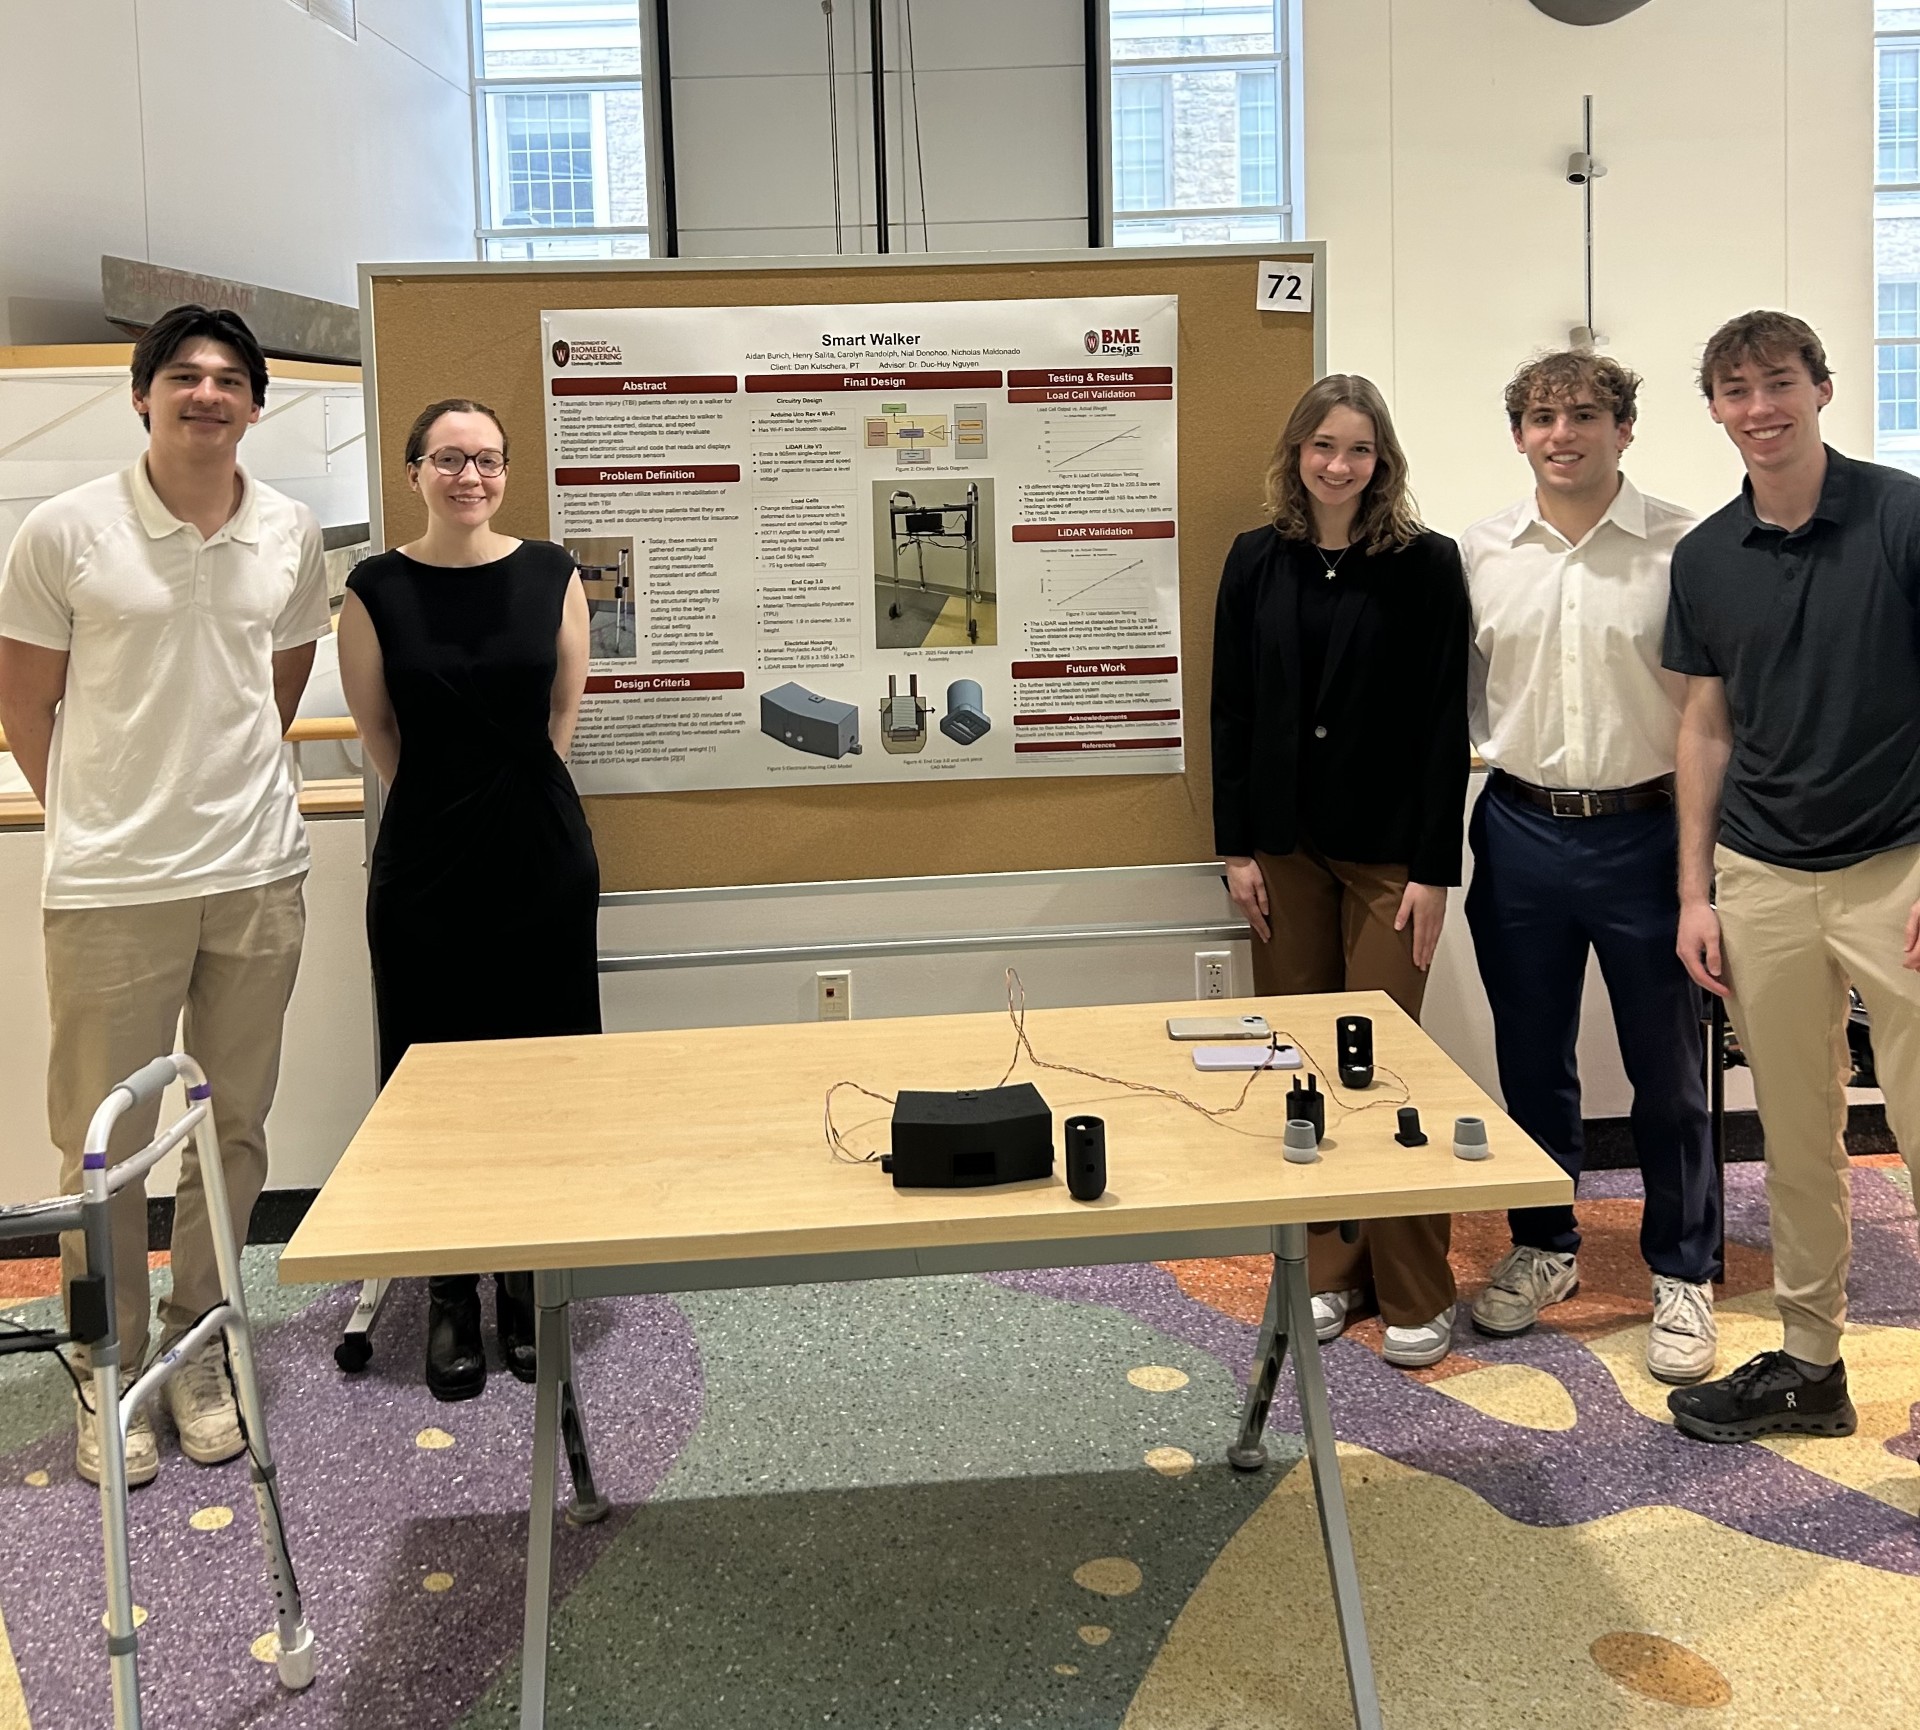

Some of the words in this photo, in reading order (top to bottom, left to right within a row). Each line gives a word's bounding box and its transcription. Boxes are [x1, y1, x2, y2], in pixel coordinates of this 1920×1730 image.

[132, 270, 254, 312] DESCENDANT
[1268, 274, 1302, 300] 72
[822, 334, 866, 346] Smart
[870, 333, 920, 345] Walker
[1102, 329, 1140, 343] BME
[1102, 344, 1140, 357] Design
[843, 377, 868, 386] Final
[870, 377, 905, 386] Design
[1049, 373, 1084, 382] Testing
[1086, 372, 1094, 382] &
[1096, 372, 1133, 381] Results
[622, 381, 666, 390] Abstract
[1071, 390, 1089, 399] Cell
[1091, 390, 1135, 398] Validation
[599, 471, 643, 480] Problem
[645, 470, 695, 479] Definition
[1057, 528, 1086, 536] LiDAR
[1088, 527, 1133, 535] Validation
[1066, 664, 1098, 673] Future
[1100, 663, 1126, 672] Work
[614, 679, 650, 689] Design
[652, 678, 690, 687] Criteria
